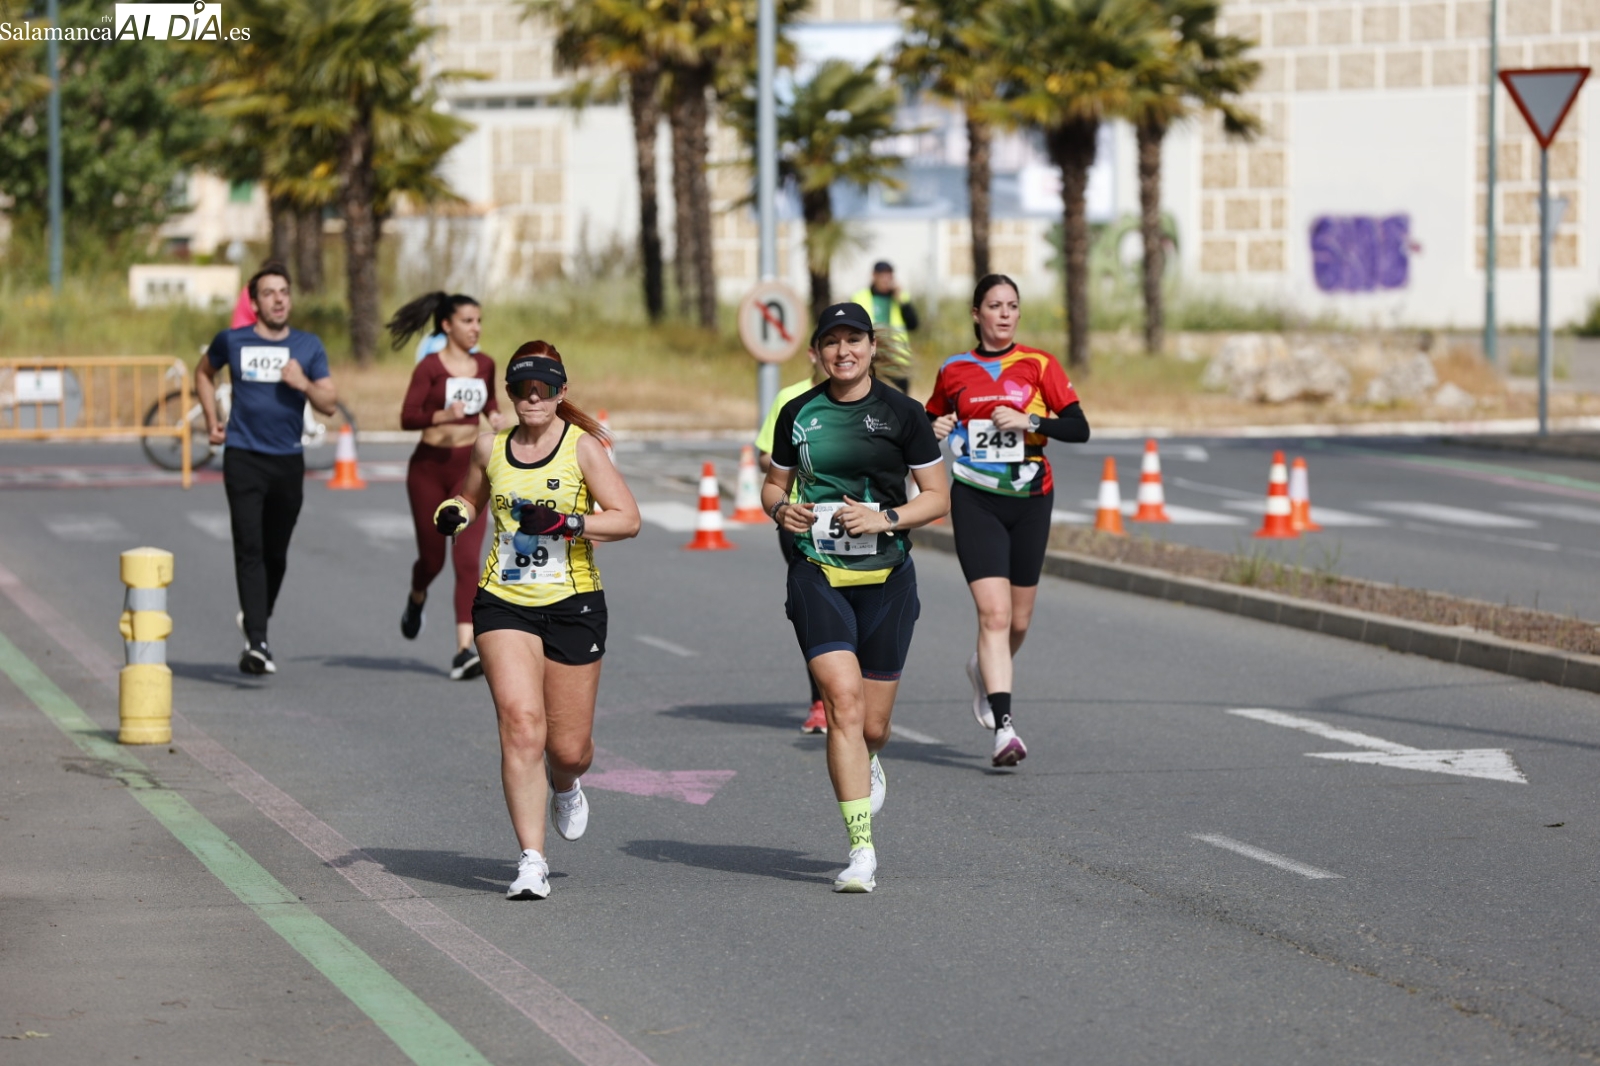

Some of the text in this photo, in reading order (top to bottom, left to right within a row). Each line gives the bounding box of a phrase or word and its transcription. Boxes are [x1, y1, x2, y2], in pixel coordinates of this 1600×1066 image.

[247, 356, 283, 370] 402
[452, 388, 482, 403] 403
[976, 431, 1018, 449] 243
[828, 513, 863, 539] 5
[515, 545, 549, 567] 89
[846, 822, 871, 836] OR
